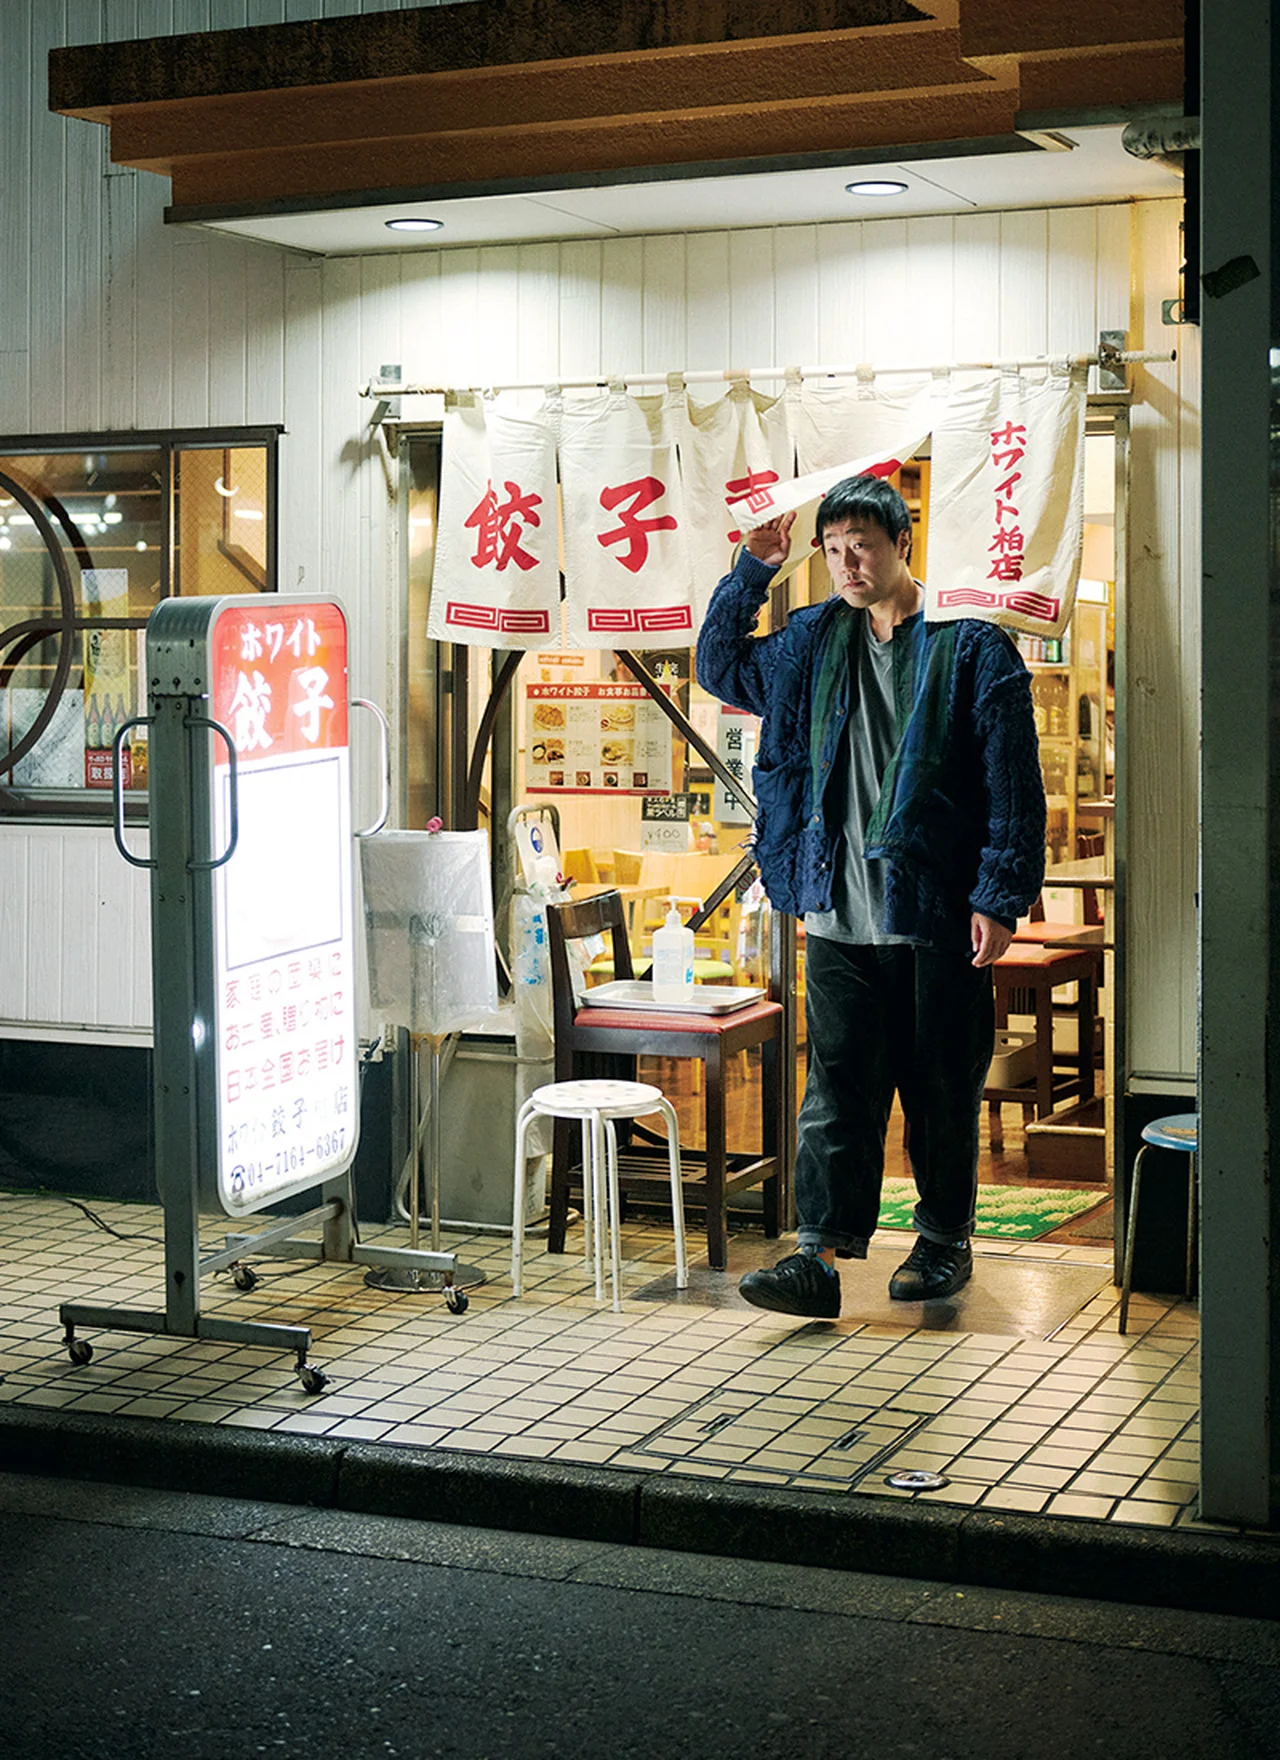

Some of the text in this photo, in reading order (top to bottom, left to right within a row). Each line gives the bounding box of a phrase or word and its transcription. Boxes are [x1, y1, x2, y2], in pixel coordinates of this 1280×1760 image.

[986, 420, 1028, 583] ホワイト柏店
[240, 619, 323, 663] ホワイト
[228, 666, 335, 752] 餃子
[724, 727, 744, 811] 営業中
[227, 1086, 348, 1154] ホワイト餃子店
